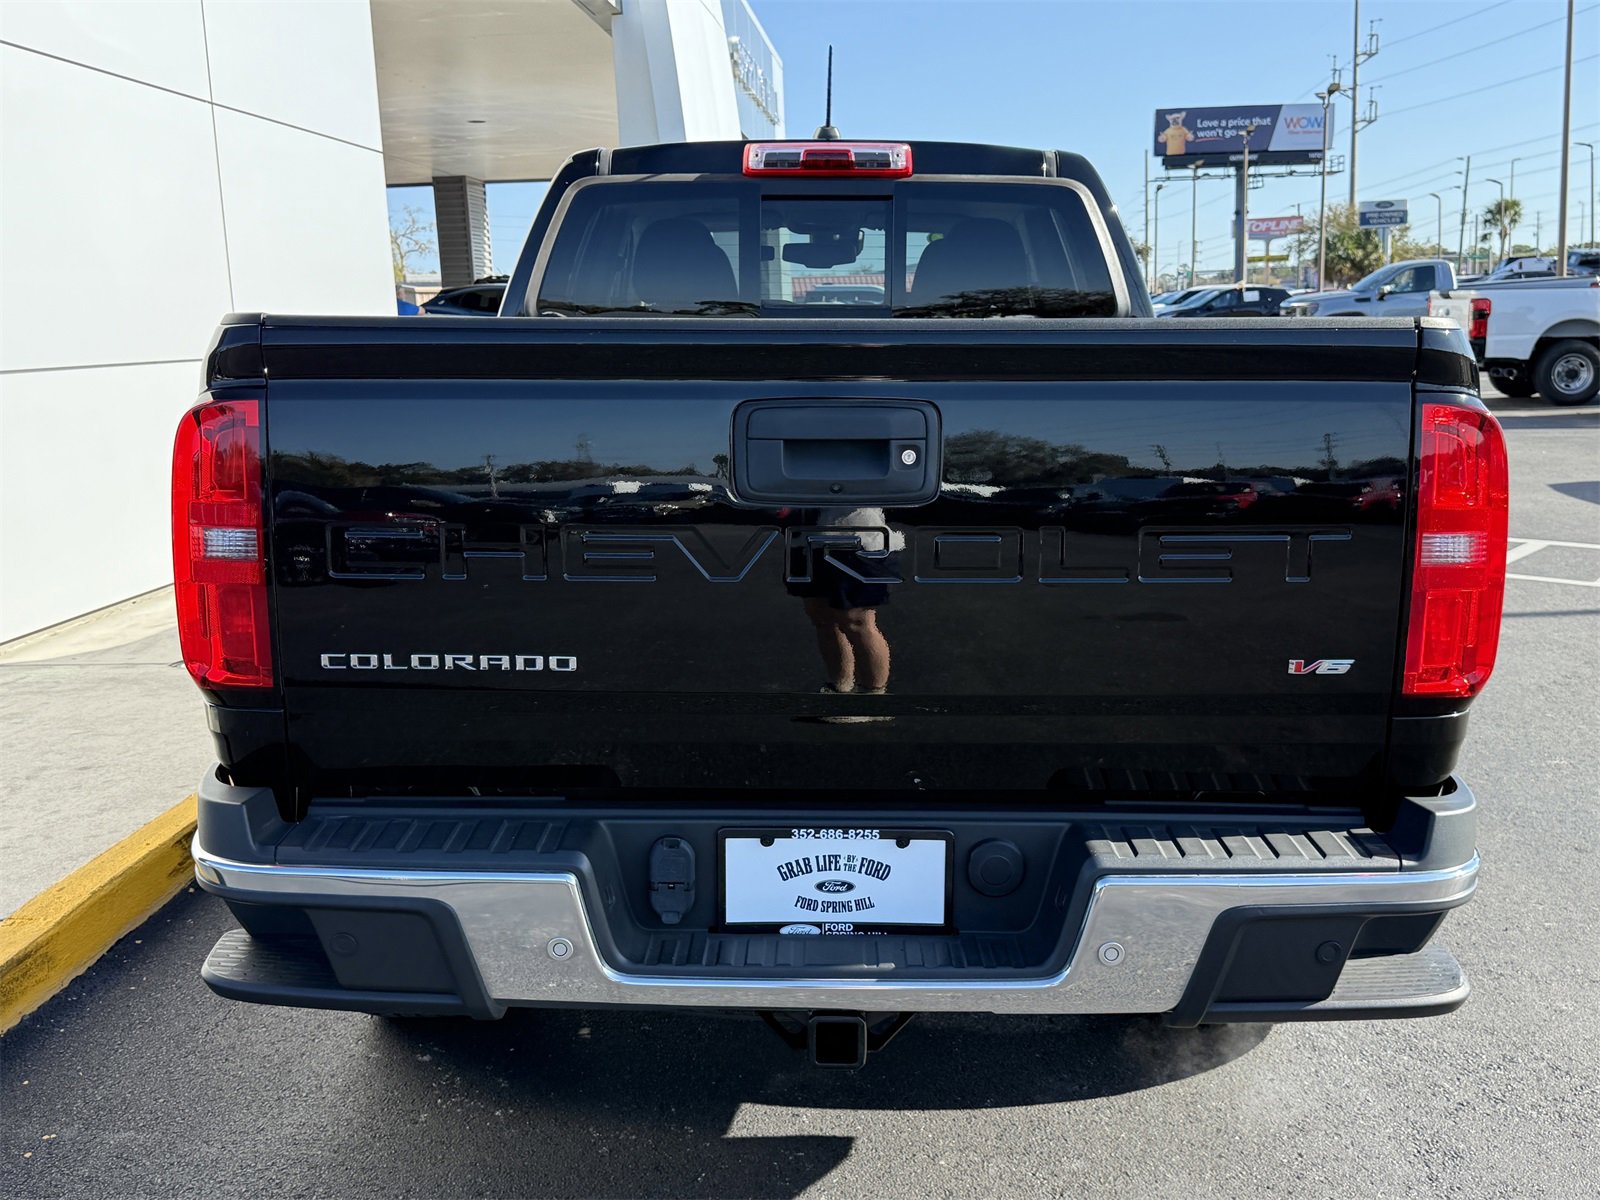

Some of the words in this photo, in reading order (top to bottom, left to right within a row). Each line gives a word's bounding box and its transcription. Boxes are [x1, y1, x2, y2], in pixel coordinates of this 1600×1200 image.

[1196, 118, 1219, 128] Love
[1228, 117, 1250, 128] price
[1252, 116, 1272, 126] that
[1196, 128, 1223, 137] won't
[1224, 129, 1238, 138] go
[326, 523, 1353, 583] CHEVROLET
[320, 652, 578, 672] COLORADO
[1288, 659, 1356, 674] V6
[791, 828, 880, 840] 352-686-8255
[815, 854, 842, 872] LIFE
[846, 854, 856, 864] BY
[776, 857, 813, 882] GRAB
[843, 864, 856, 872] THE
[858, 857, 892, 882] FORD
[821, 881, 849, 893] Ford
[794, 895, 819, 912] FORD
[820, 900, 853, 914] SPRING
[854, 896, 876, 912] HILL
[825, 923, 854, 932] FORD
